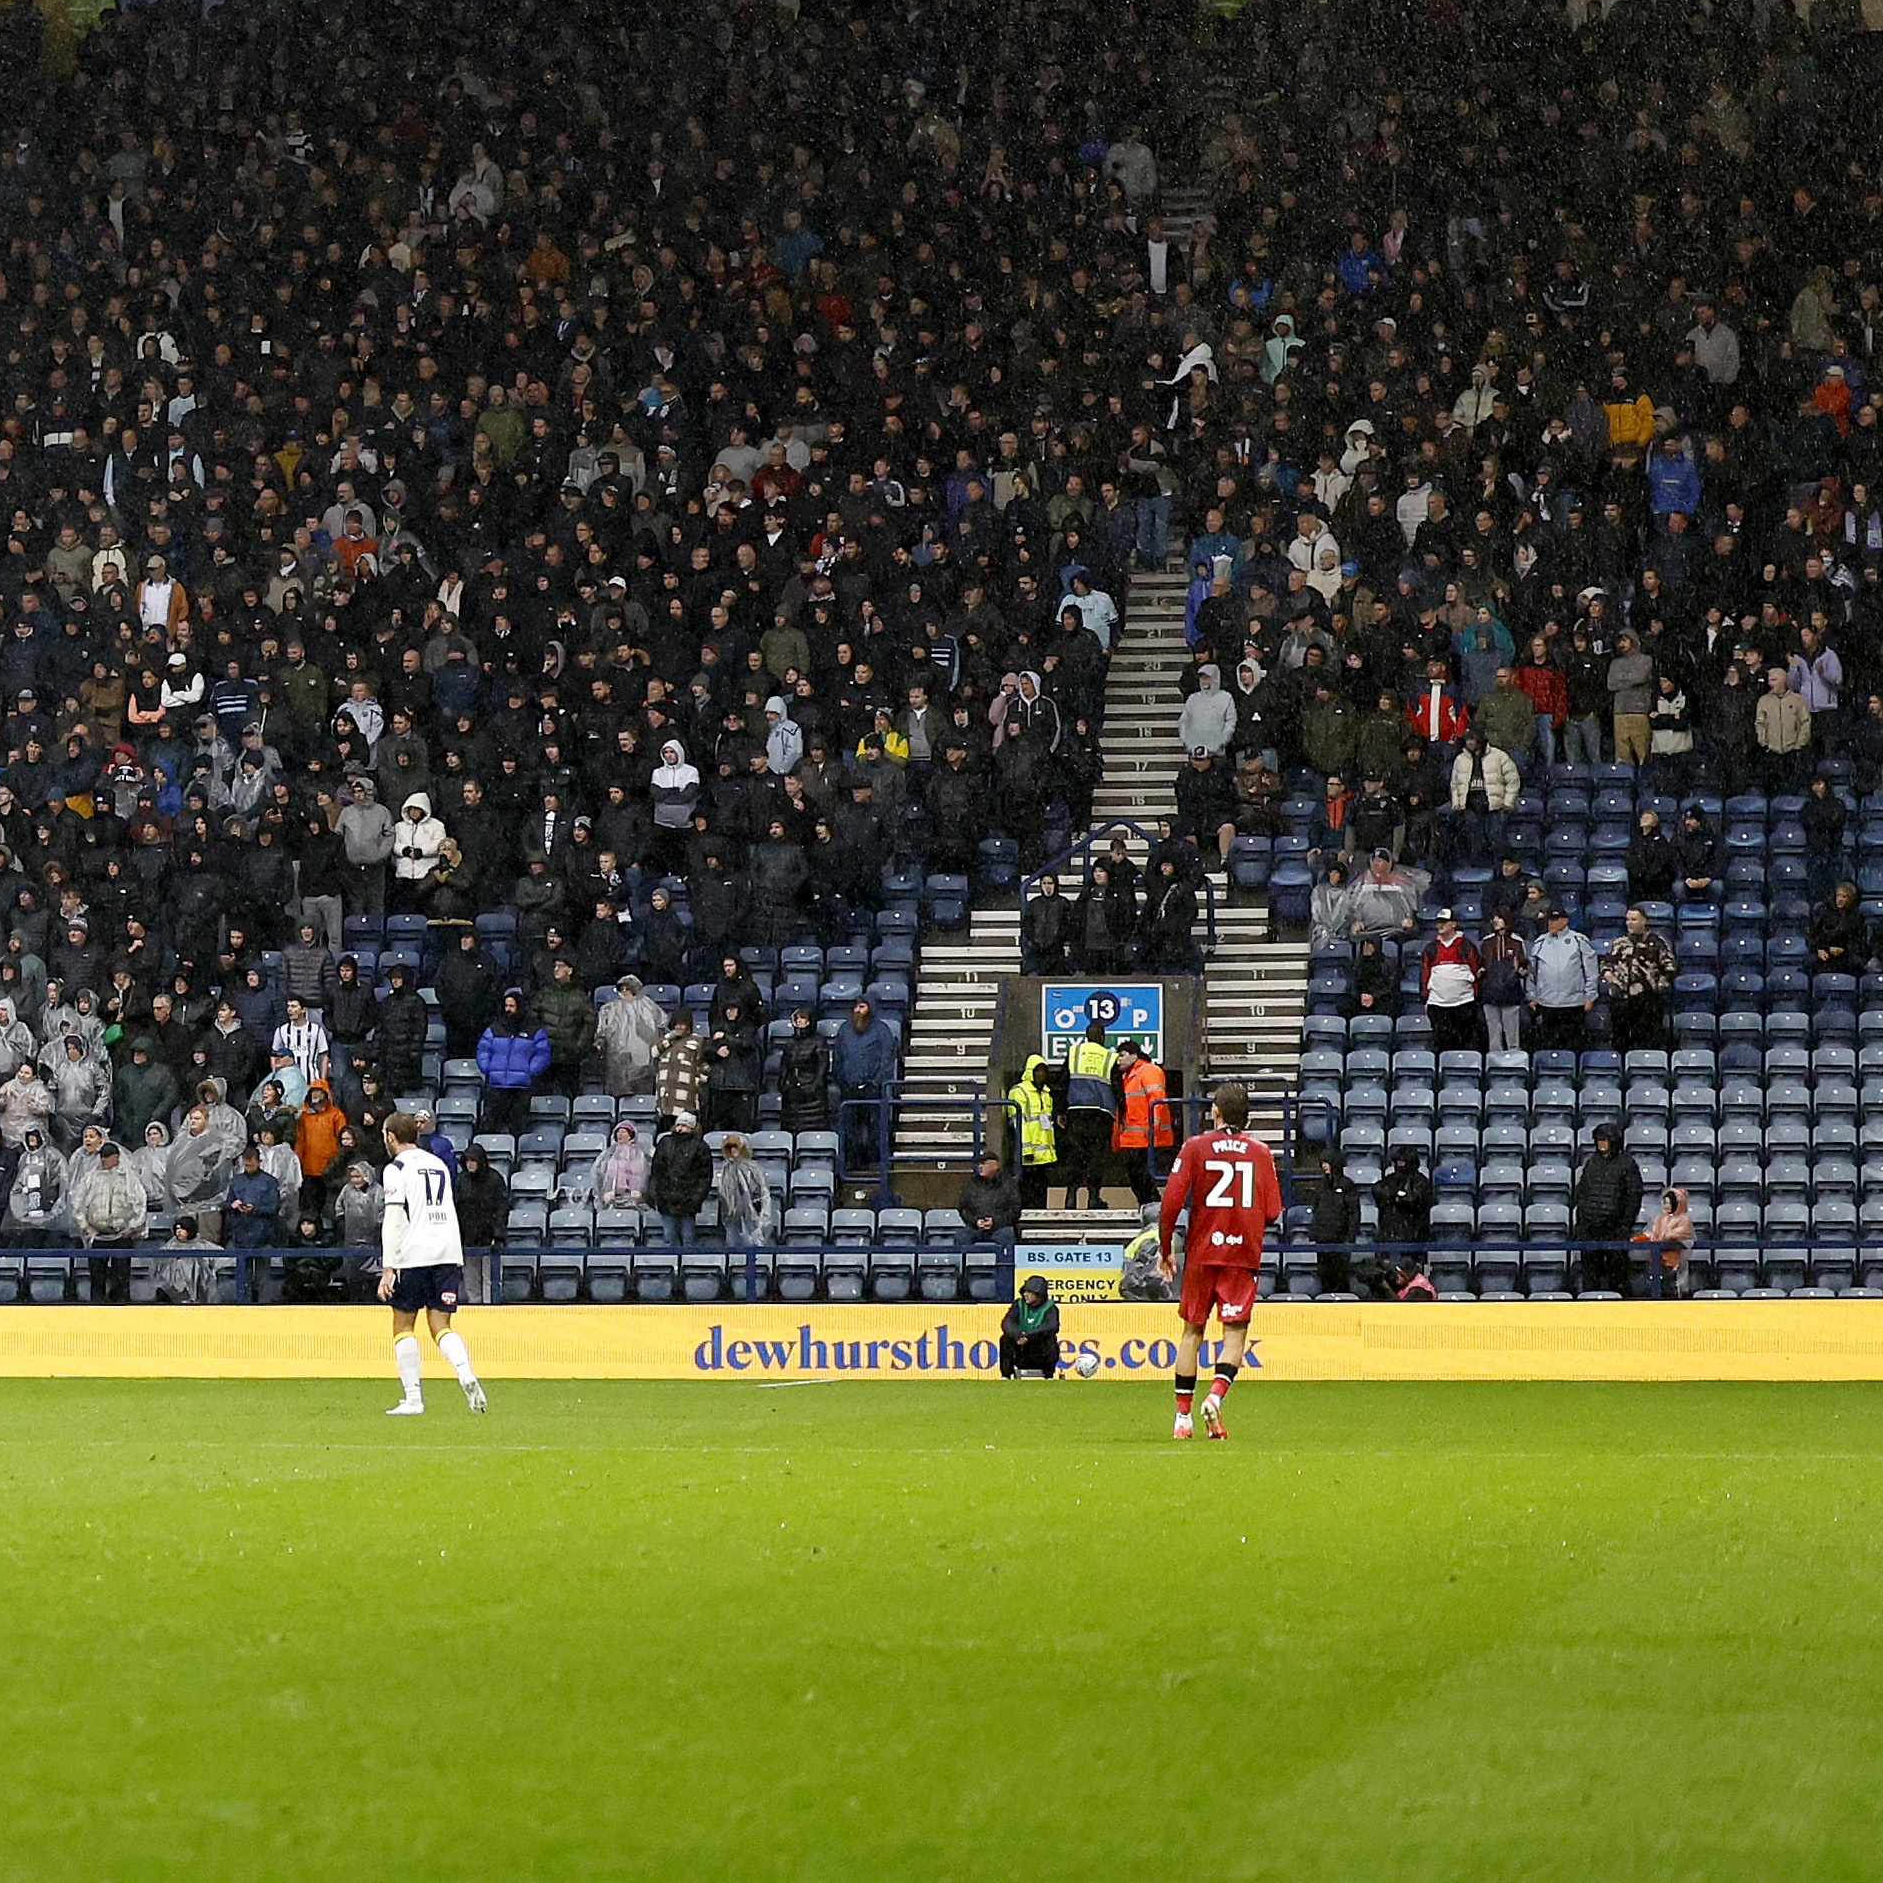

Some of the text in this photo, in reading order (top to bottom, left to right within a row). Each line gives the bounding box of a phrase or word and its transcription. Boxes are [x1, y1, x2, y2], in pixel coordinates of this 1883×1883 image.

[1054, 1000, 1148, 1028] O 13 P
[1249, 1006, 1265, 1016] 10
[1212, 1139, 1248, 1154] PRICE
[418, 1169, 446, 1206] 17
[1205, 1160, 1254, 1208] 21
[1226, 1234, 1243, 1246] dpd
[1028, 1253, 1112, 1262] BS. GATE 13
[1045, 1280, 1115, 1290] ERGENCY
[694, 1324, 1264, 1370] dewhursthoes.couk
